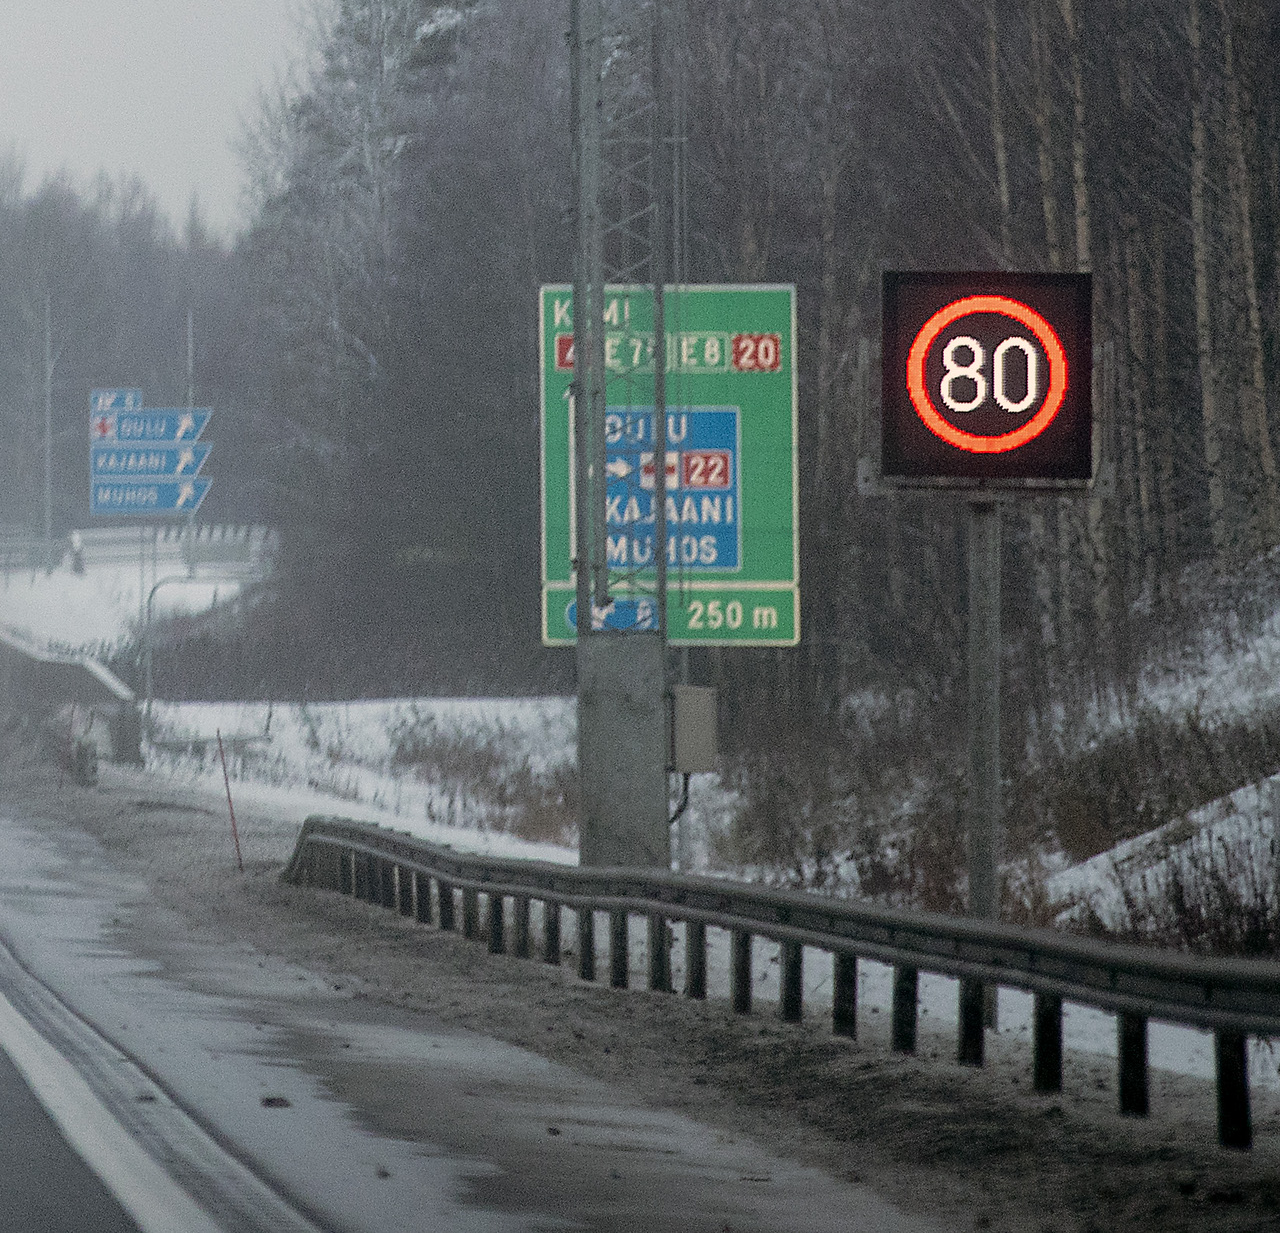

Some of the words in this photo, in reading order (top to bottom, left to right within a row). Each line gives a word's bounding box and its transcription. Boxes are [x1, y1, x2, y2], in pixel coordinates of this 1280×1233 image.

[553, 298, 630, 328] KMI
[738, 338, 776, 367] 20
[940, 335, 1038, 412] 80
[689, 455, 725, 484] 22
[687, 600, 743, 630] 250
[752, 605, 779, 630] m
